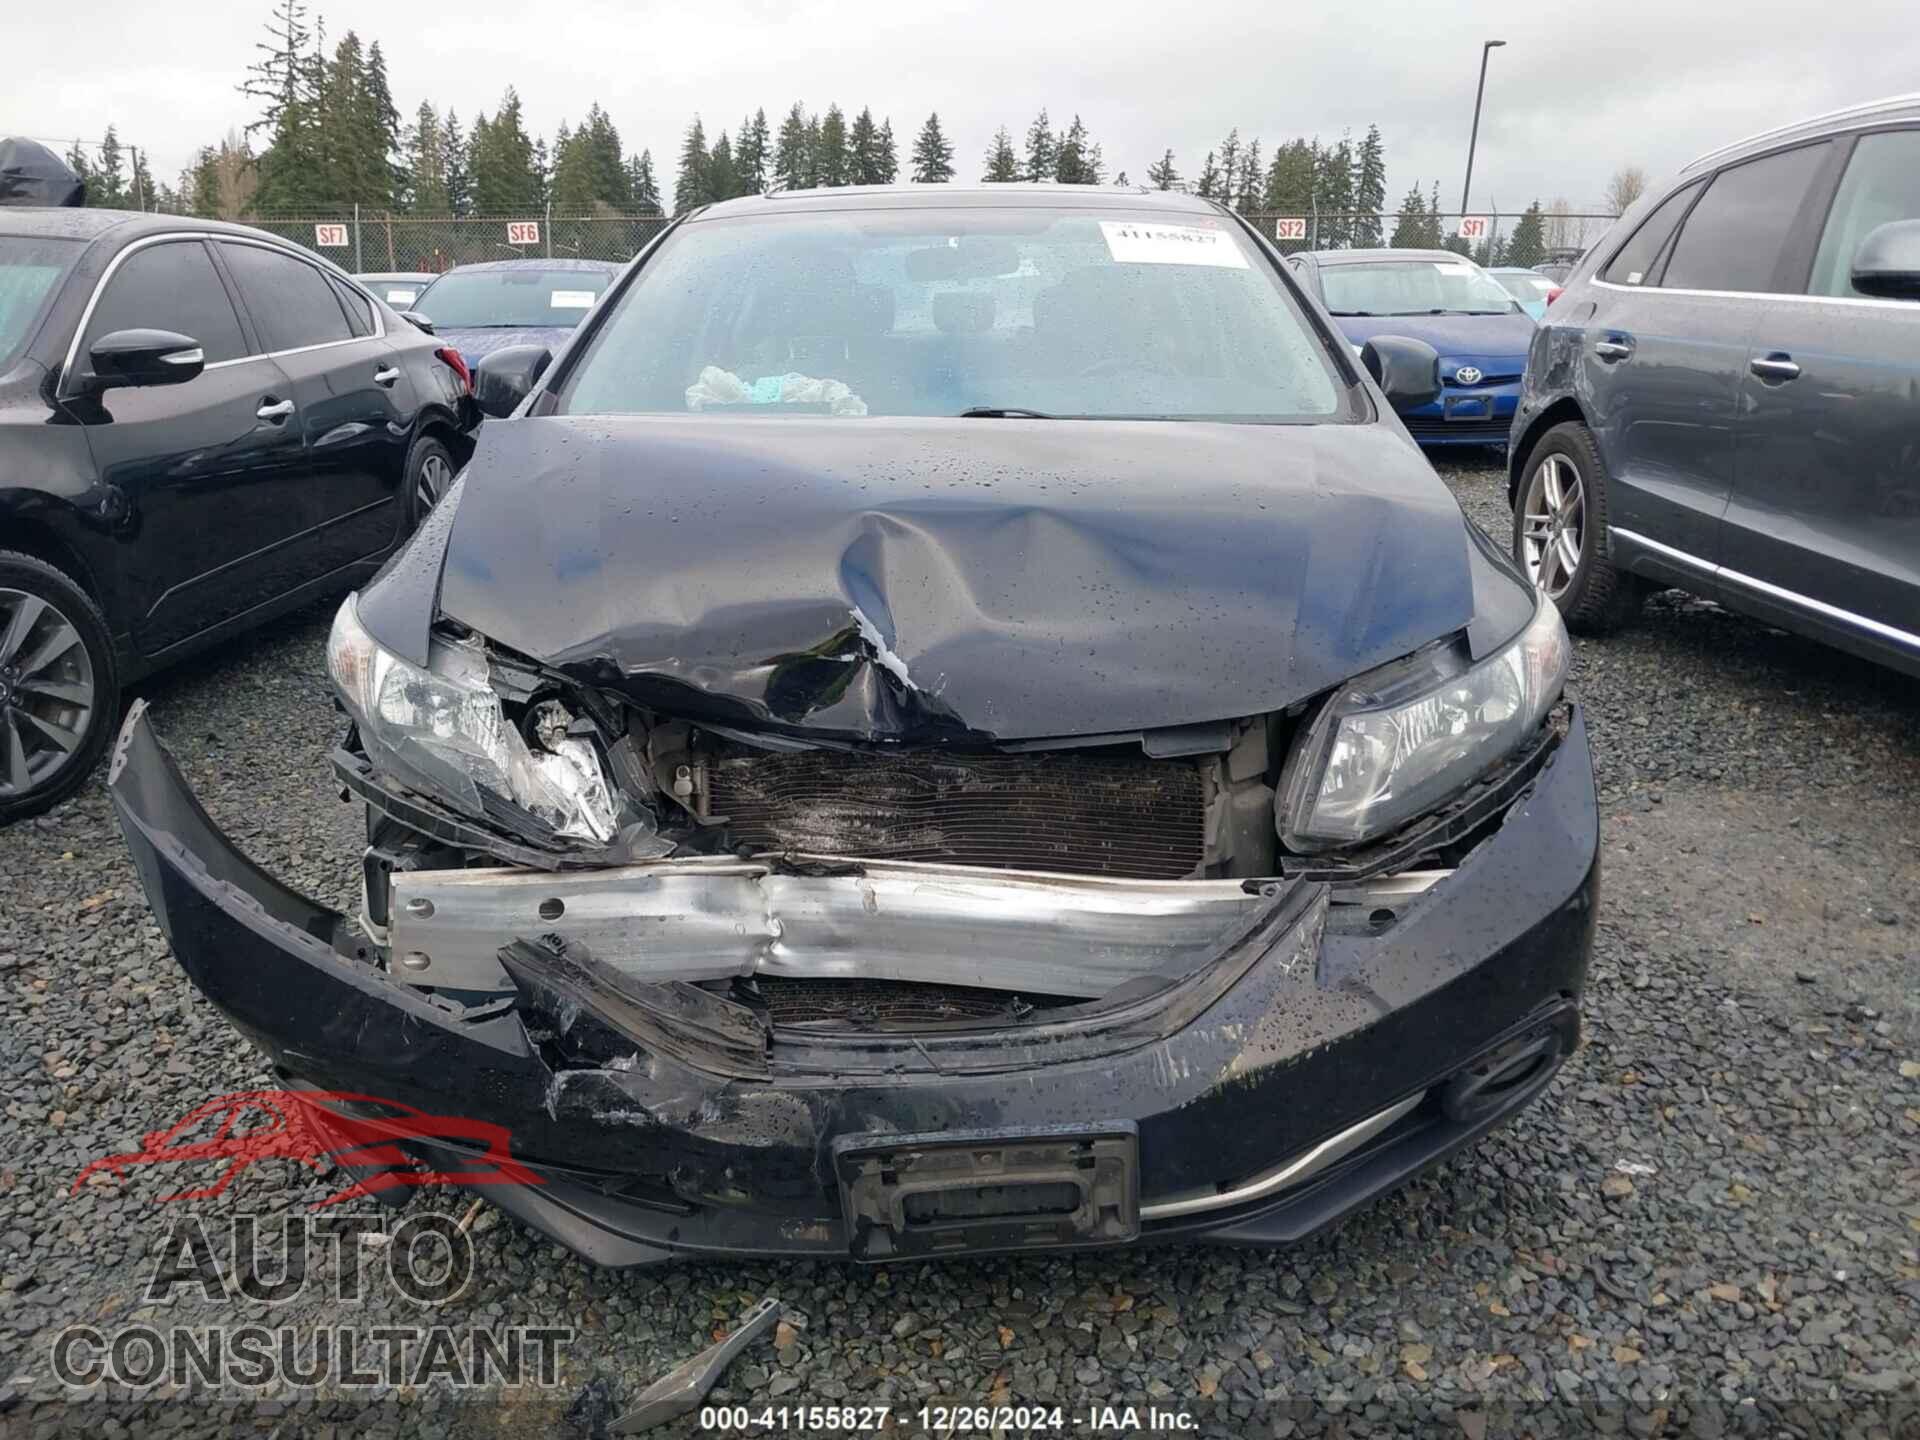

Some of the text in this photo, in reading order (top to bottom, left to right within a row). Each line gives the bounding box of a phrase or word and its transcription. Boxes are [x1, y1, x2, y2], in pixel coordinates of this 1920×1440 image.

[319, 226, 344, 244] SF7
[511, 224, 537, 241] SF6
[1278, 221, 1303, 237] SF2
[1463, 219, 1484, 236] SF1
